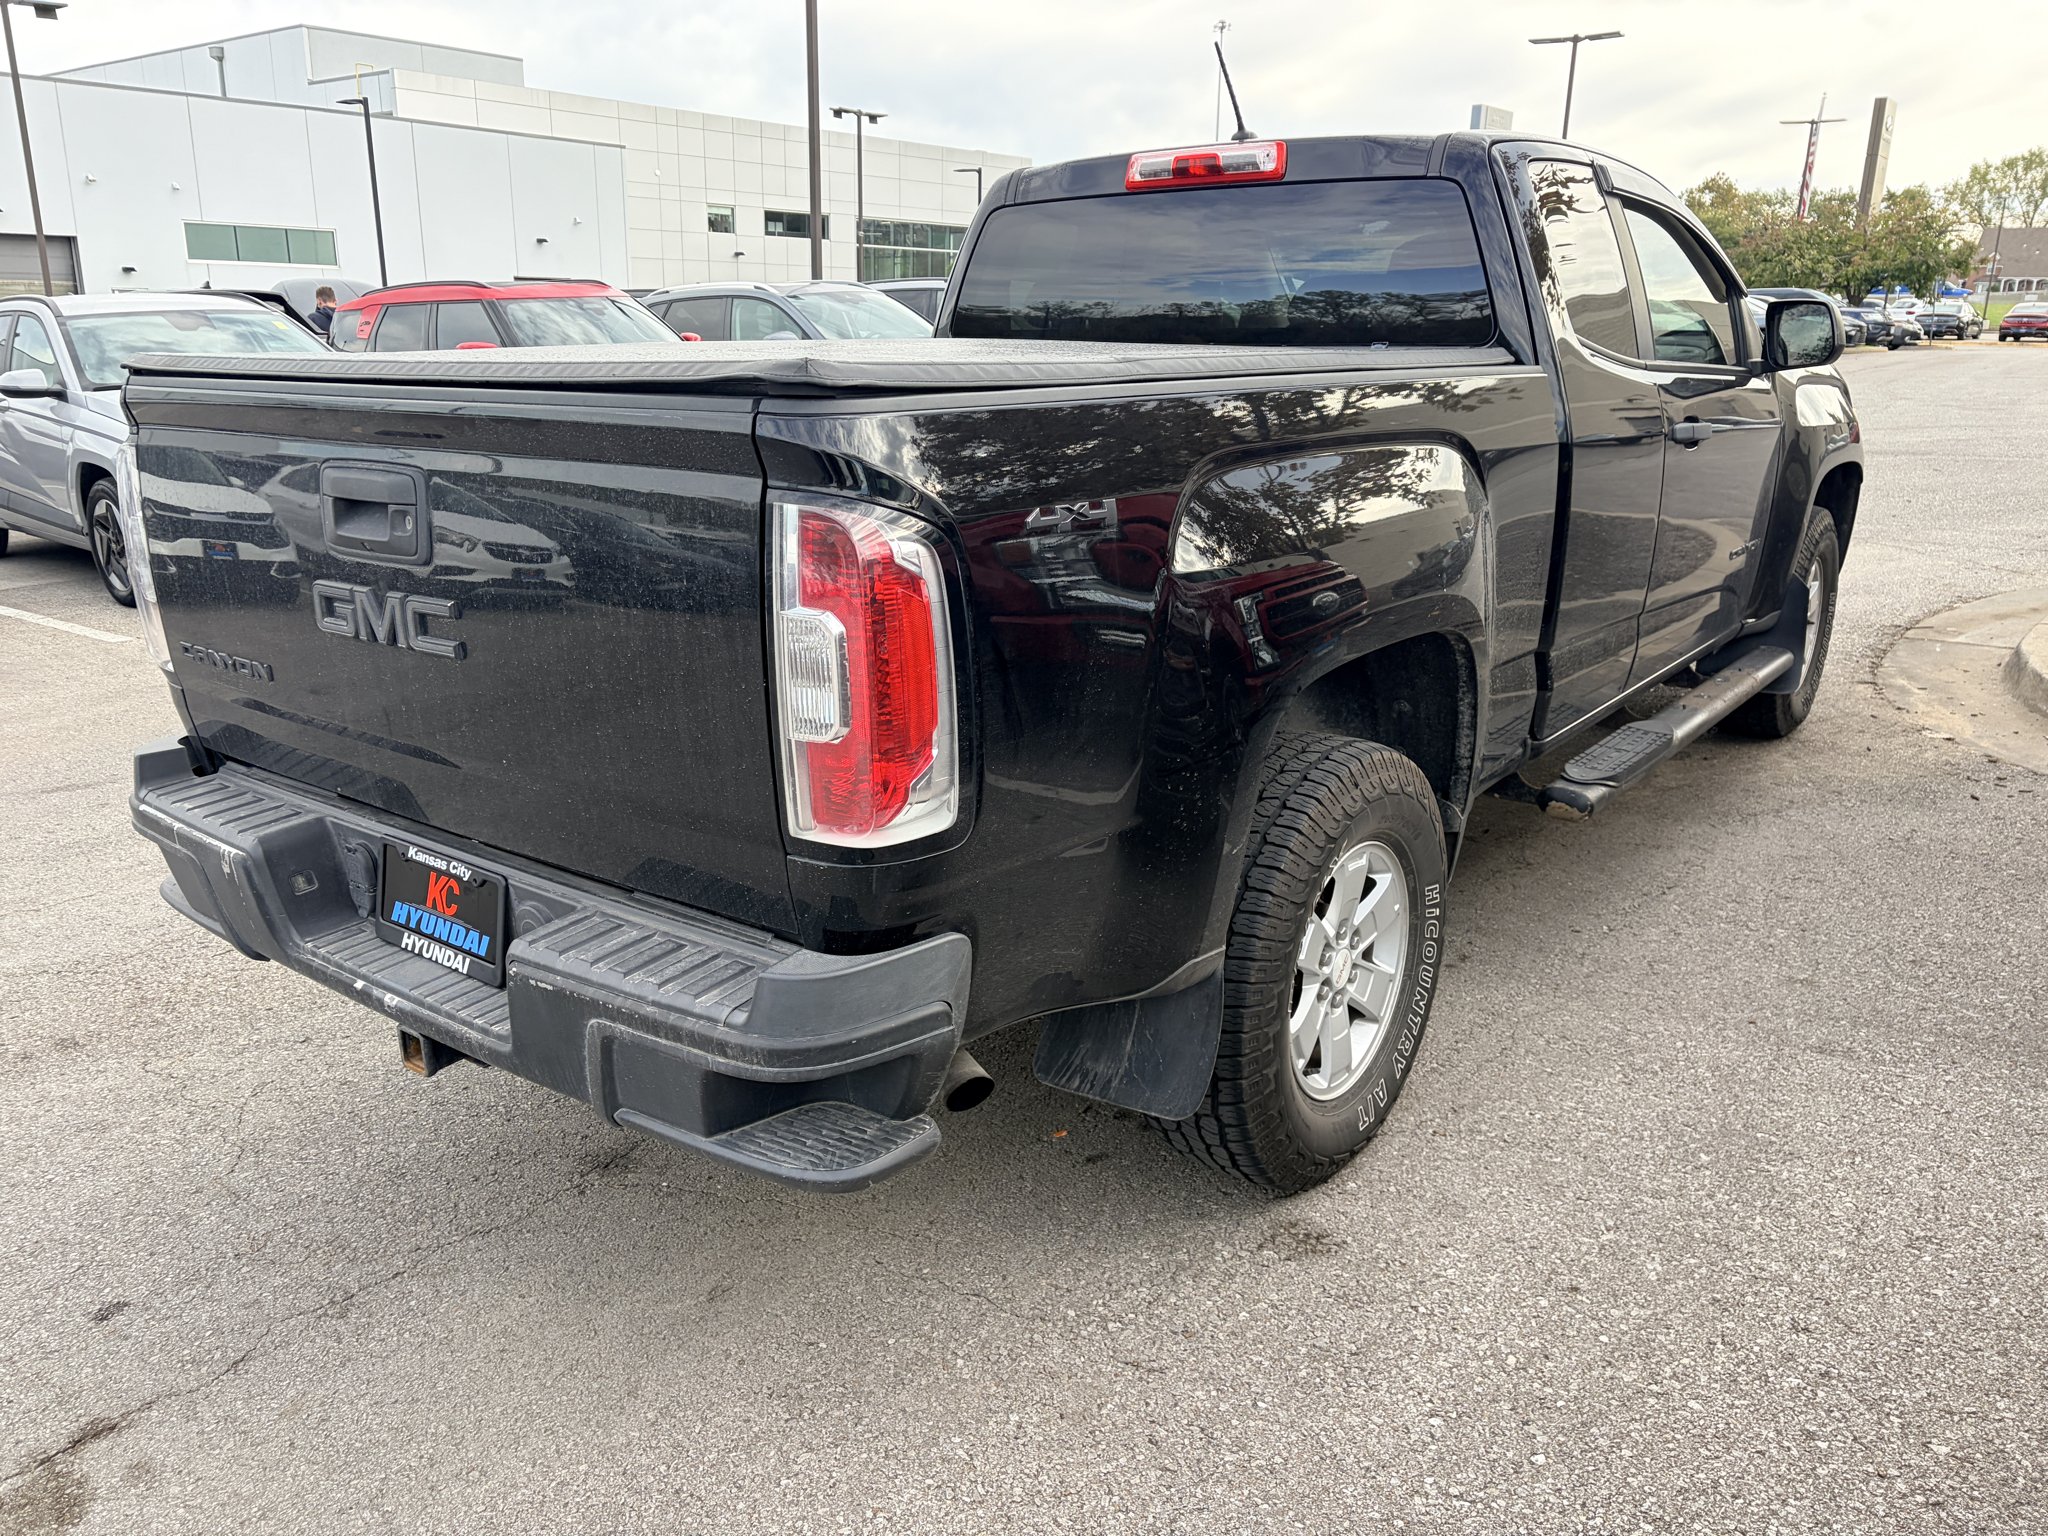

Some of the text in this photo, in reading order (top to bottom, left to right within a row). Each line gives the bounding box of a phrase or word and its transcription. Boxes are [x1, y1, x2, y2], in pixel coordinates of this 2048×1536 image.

[313, 579, 467, 660] GMC
[179, 640, 274, 682] CANYON
[407, 846, 472, 881] Kansas City
[426, 871, 460, 916] KC
[391, 900, 490, 957] HYUNDAI
[401, 932, 470, 974] HYUNDAI
[1358, 1078, 1388, 1131] A/T
